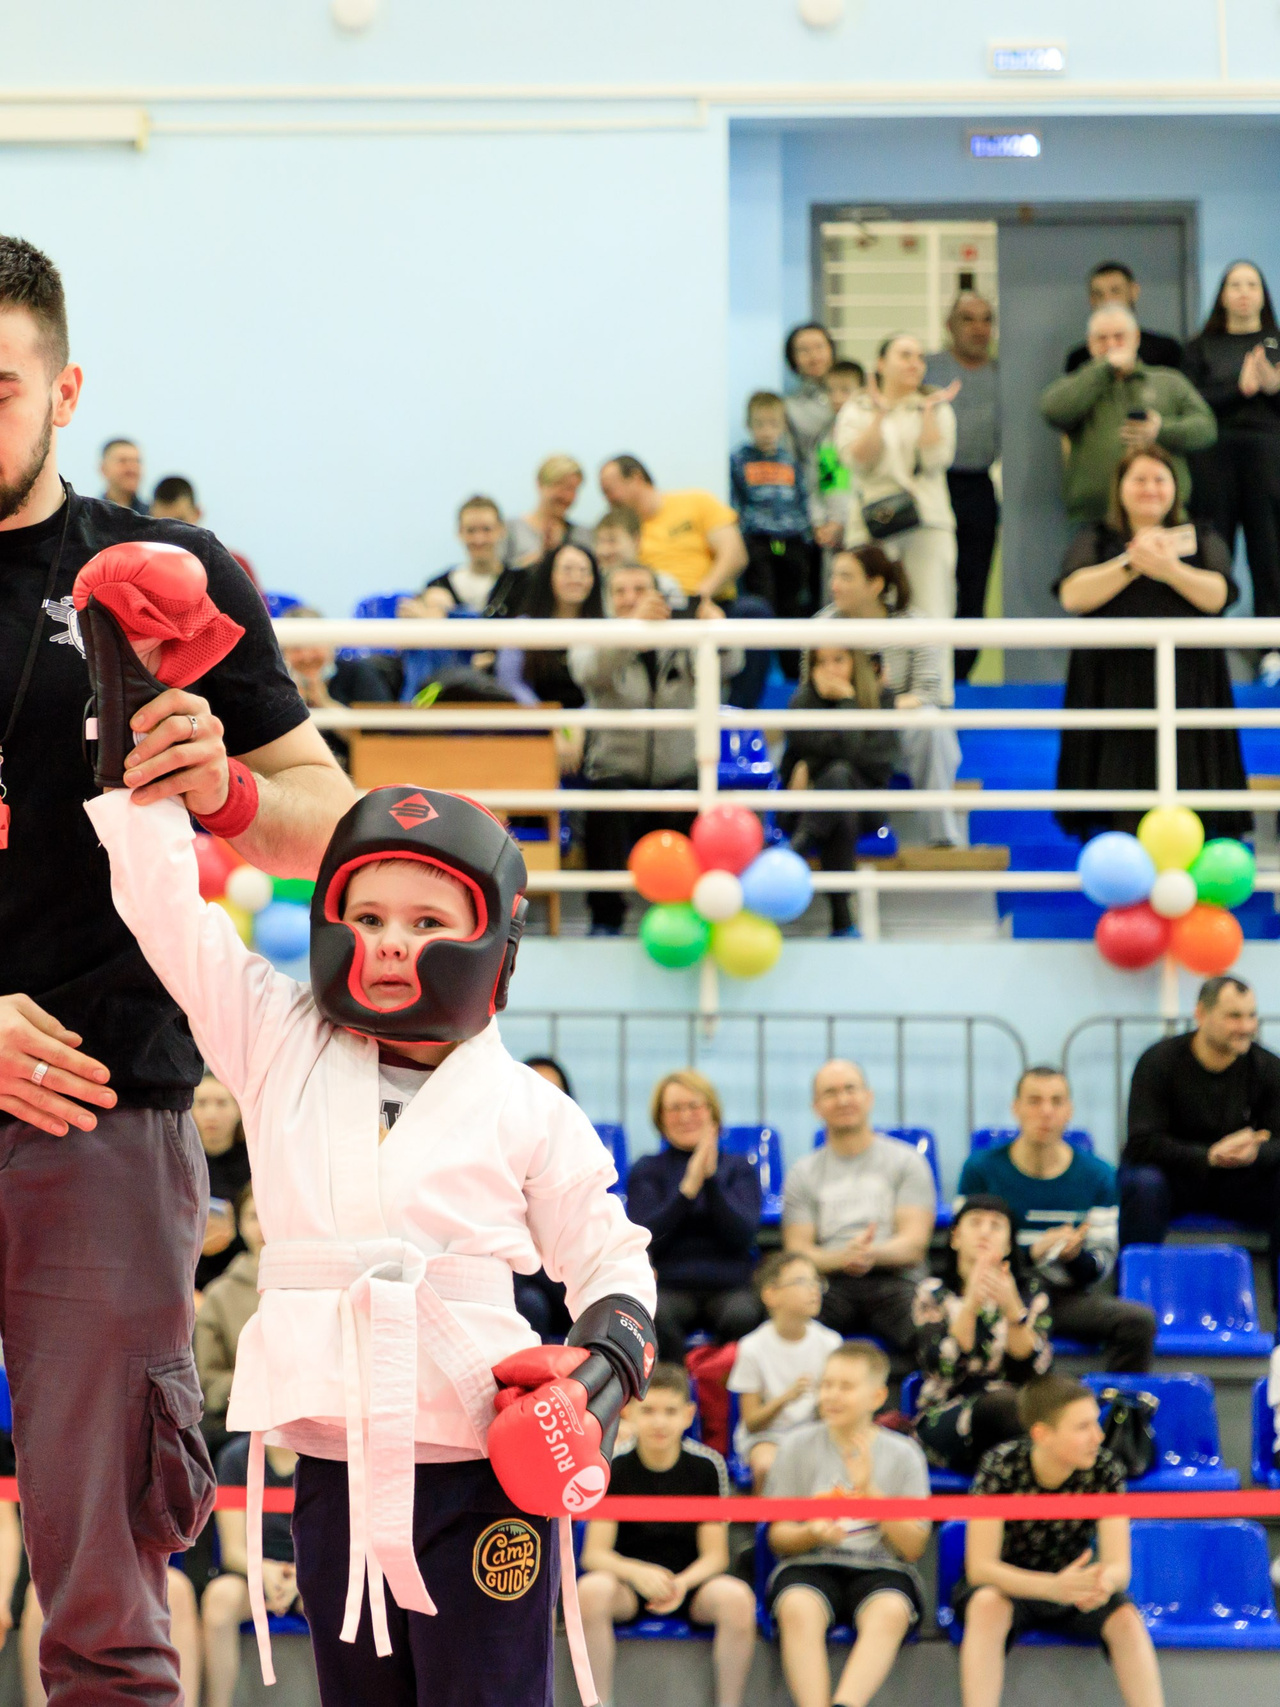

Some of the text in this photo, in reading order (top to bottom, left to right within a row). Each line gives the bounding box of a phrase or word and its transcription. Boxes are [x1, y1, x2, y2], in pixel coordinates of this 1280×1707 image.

[620, 1318, 646, 1348] RUSCO
[549, 1396, 572, 1433] SPORT
[533, 1400, 576, 1473] RUSCO
[481, 1532, 535, 1572] Camp
[485, 1568, 531, 1593] GUIDE
